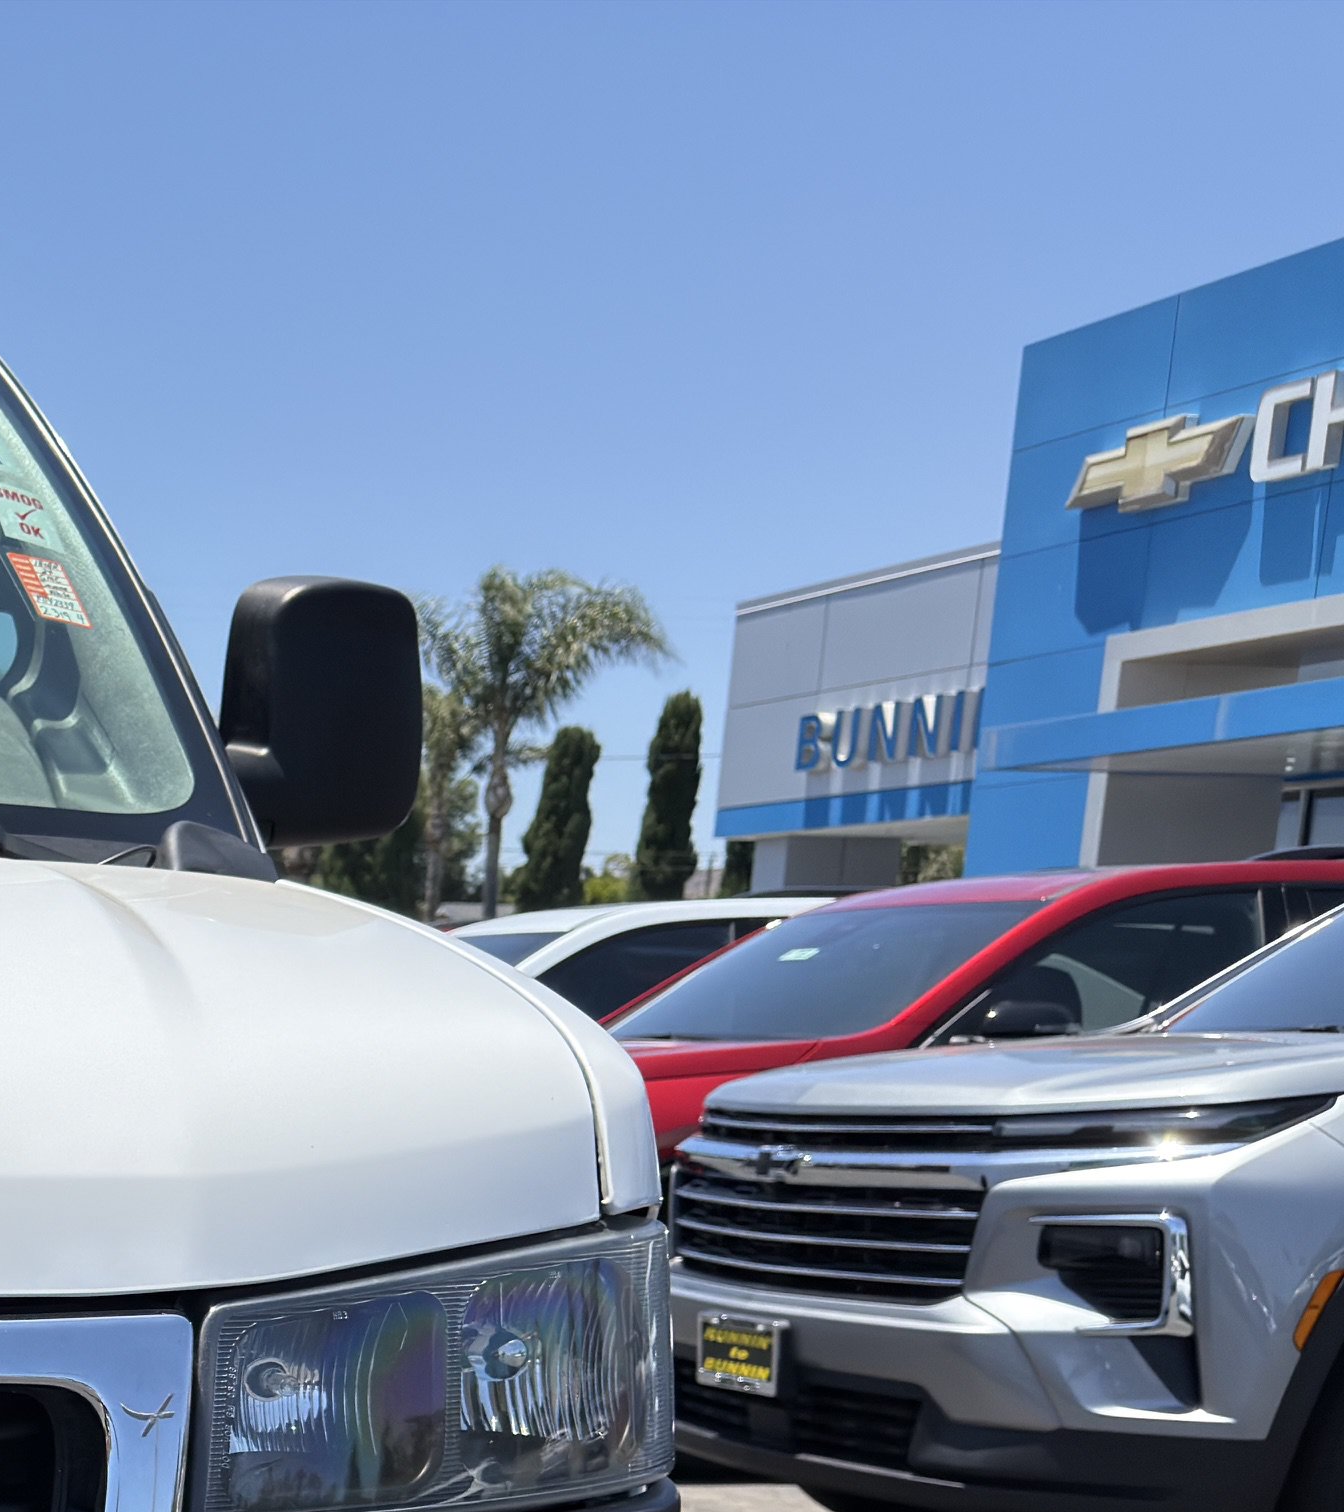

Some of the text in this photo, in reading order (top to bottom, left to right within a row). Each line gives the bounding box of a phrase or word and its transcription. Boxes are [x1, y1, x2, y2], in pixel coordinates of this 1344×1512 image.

[19, 522, 45, 540] OK
[796, 687, 984, 773] BUNNI
[729, 1346, 749, 1360] to
